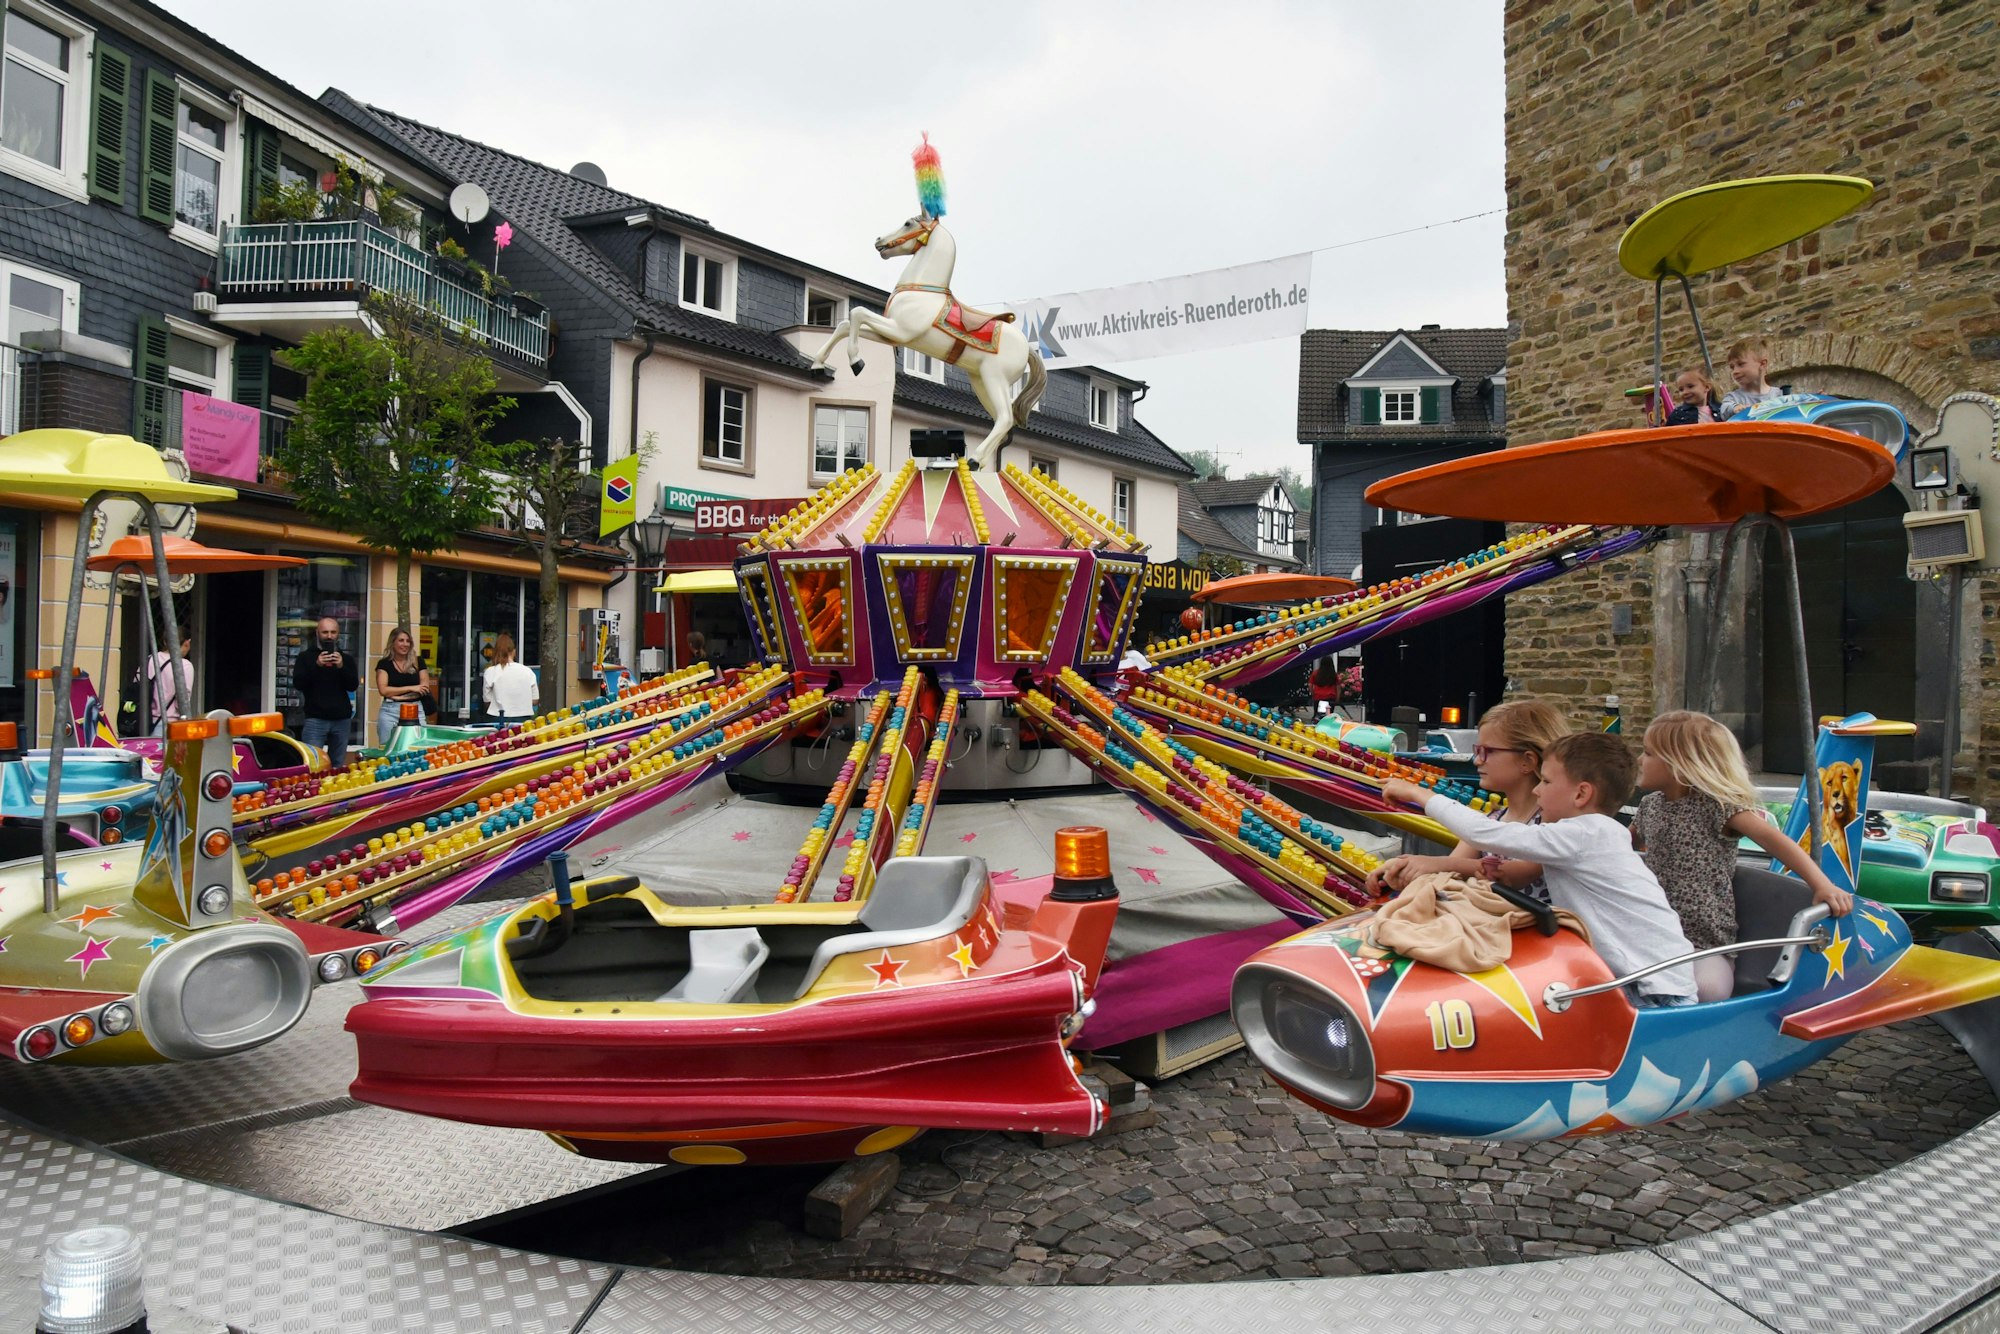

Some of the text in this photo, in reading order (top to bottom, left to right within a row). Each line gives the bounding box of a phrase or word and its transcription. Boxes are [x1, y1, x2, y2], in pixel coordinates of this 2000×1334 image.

[1058, 283, 1307, 341] www.Aktivkreis-Ruenderoth.de
[697, 505, 745, 528] BBQ
[750, 514, 765, 525] for
[1424, 999, 1476, 1051] 10
